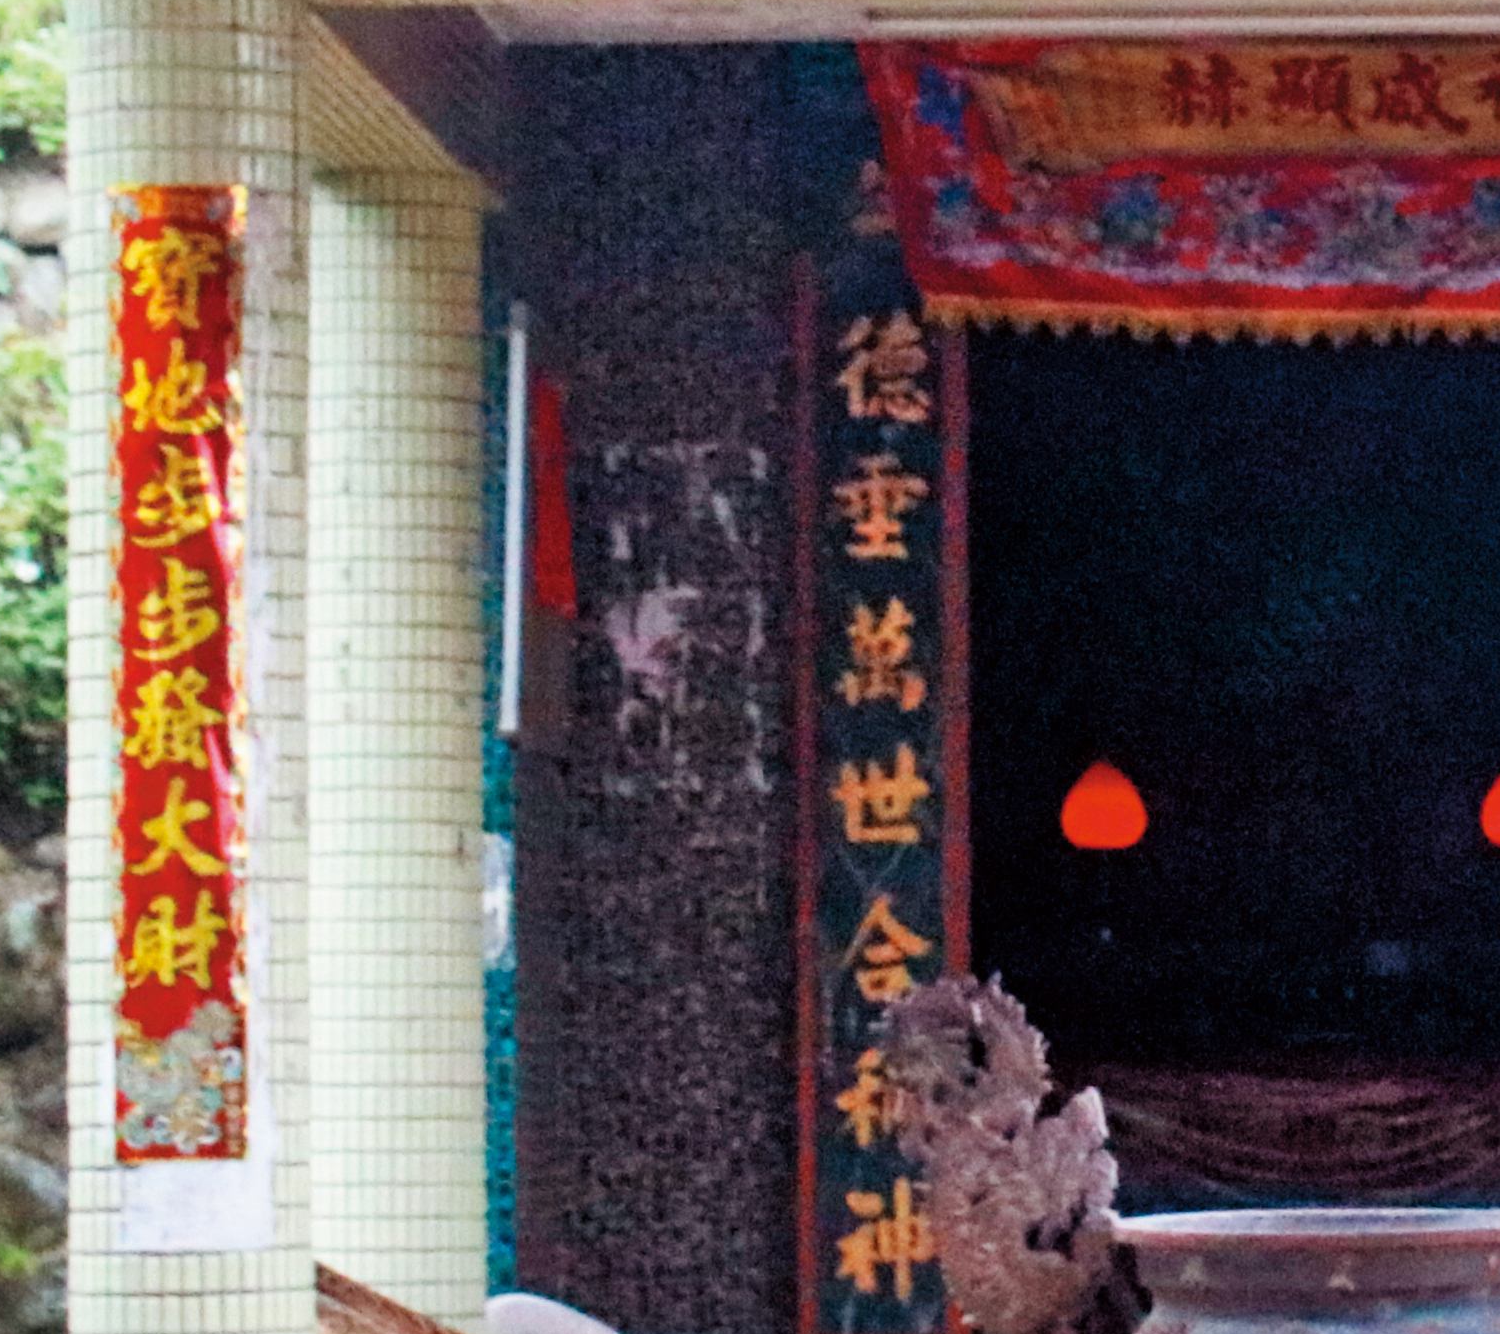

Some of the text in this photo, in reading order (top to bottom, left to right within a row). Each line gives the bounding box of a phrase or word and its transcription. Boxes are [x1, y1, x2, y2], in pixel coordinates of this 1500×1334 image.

[122, 225, 229, 990] 寶地步步發大財
